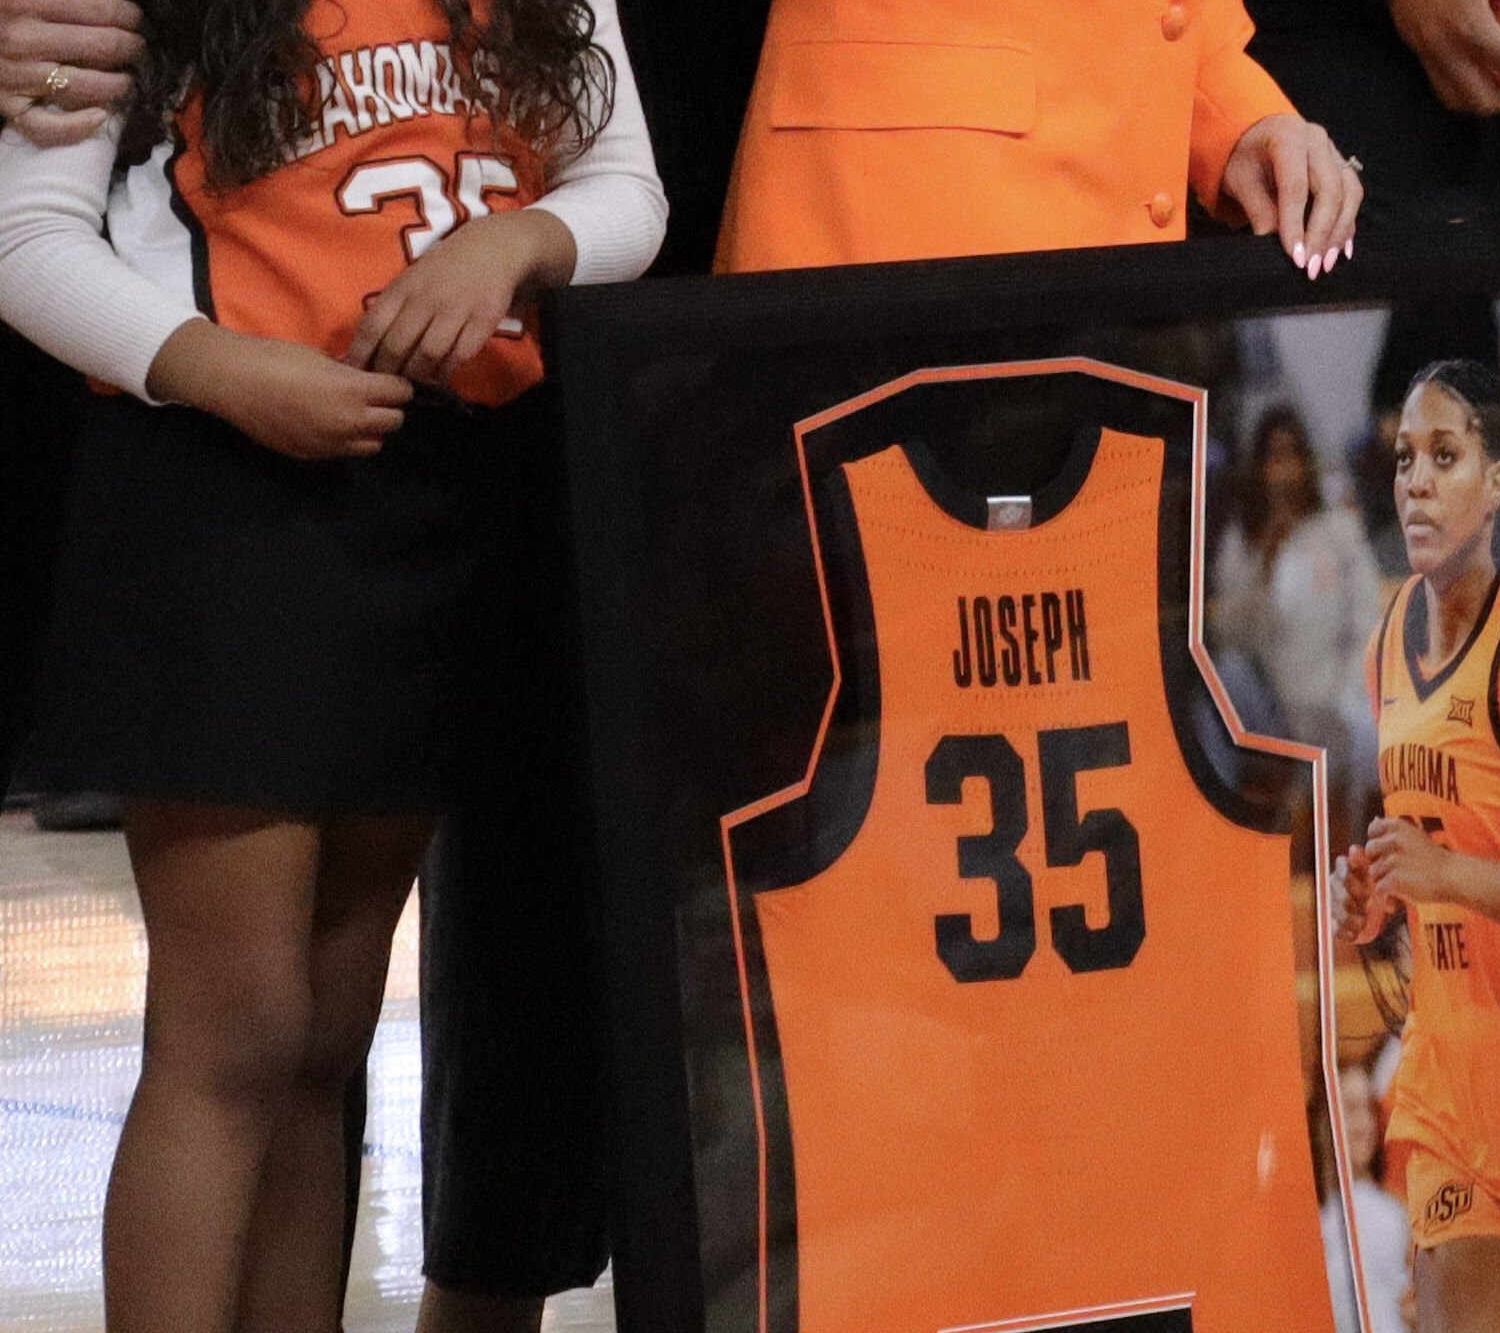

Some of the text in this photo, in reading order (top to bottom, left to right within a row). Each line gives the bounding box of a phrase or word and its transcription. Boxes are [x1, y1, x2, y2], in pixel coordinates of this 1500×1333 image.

[953, 588, 1092, 689] JOSEPH
[924, 719, 1147, 984] 35
[1425, 1180, 1474, 1229] OSU
